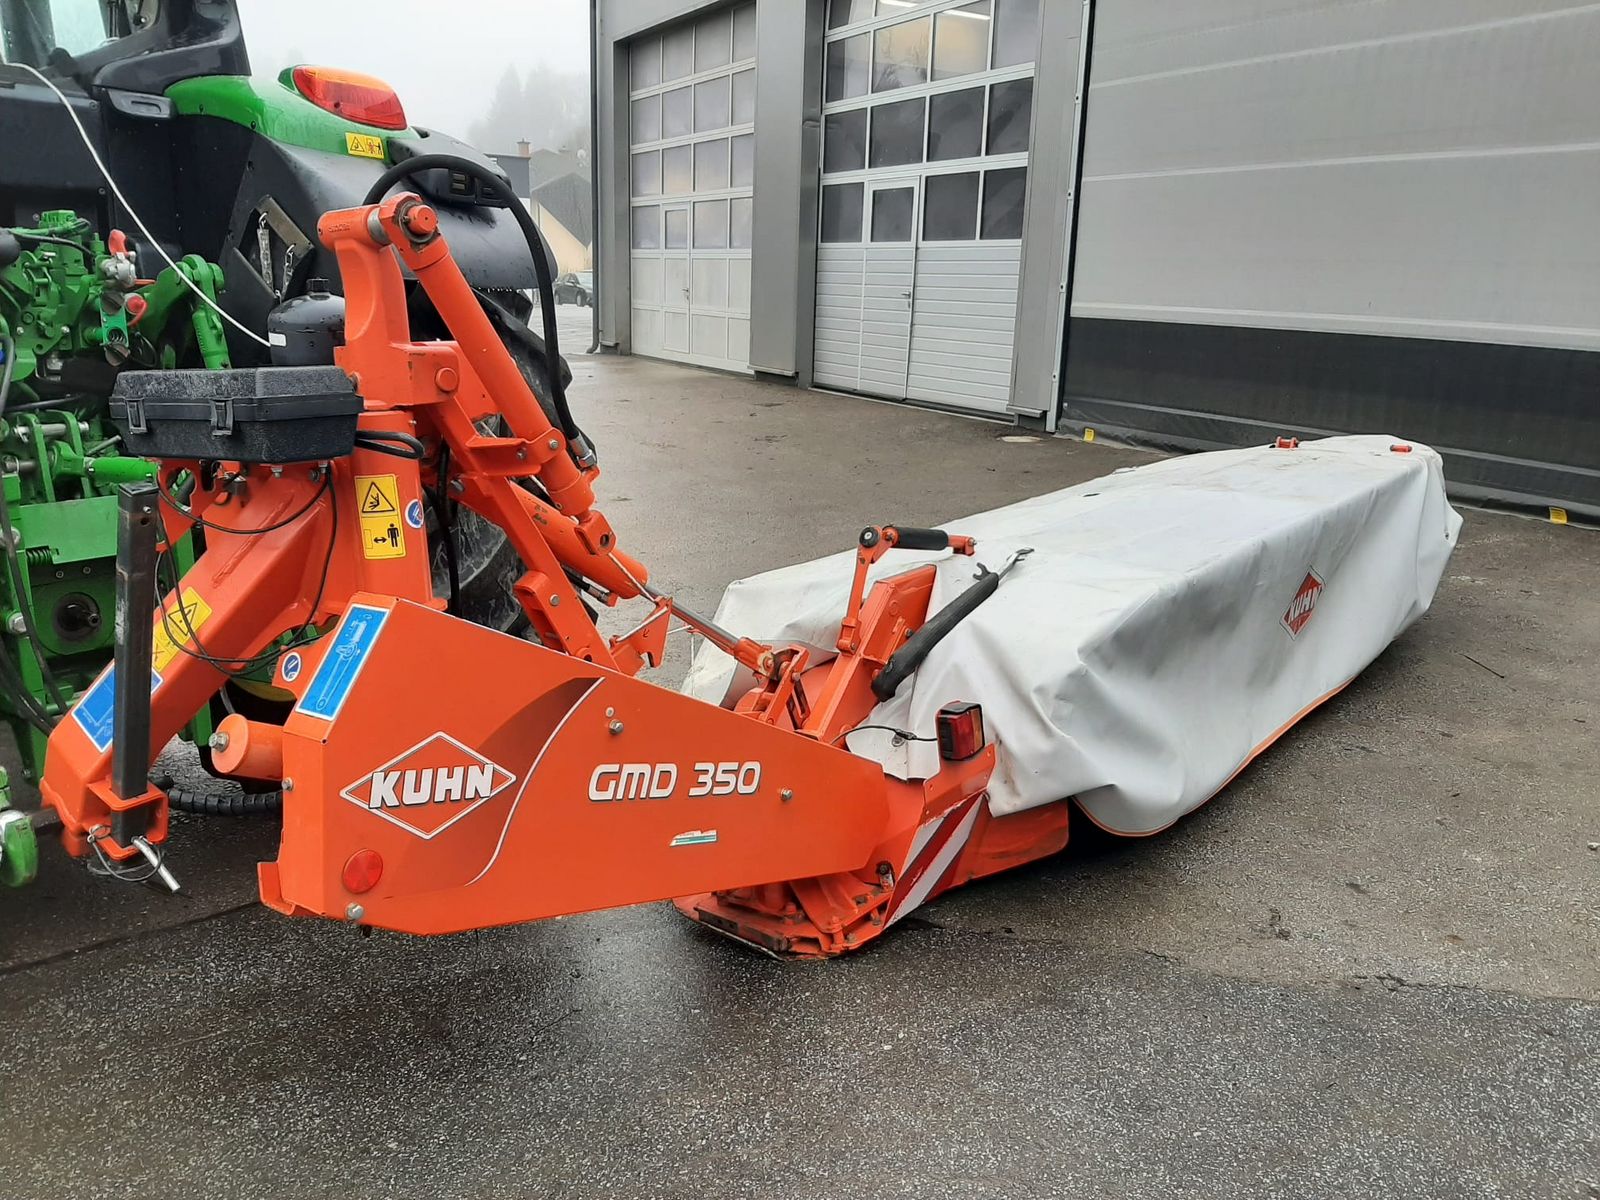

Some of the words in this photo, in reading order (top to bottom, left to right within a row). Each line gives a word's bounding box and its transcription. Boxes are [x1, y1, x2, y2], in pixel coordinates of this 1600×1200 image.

[1287, 585, 1323, 625] KUHN
[369, 763, 494, 809] KUHN
[588, 762, 678, 801] GMD
[688, 761, 761, 796] 350
